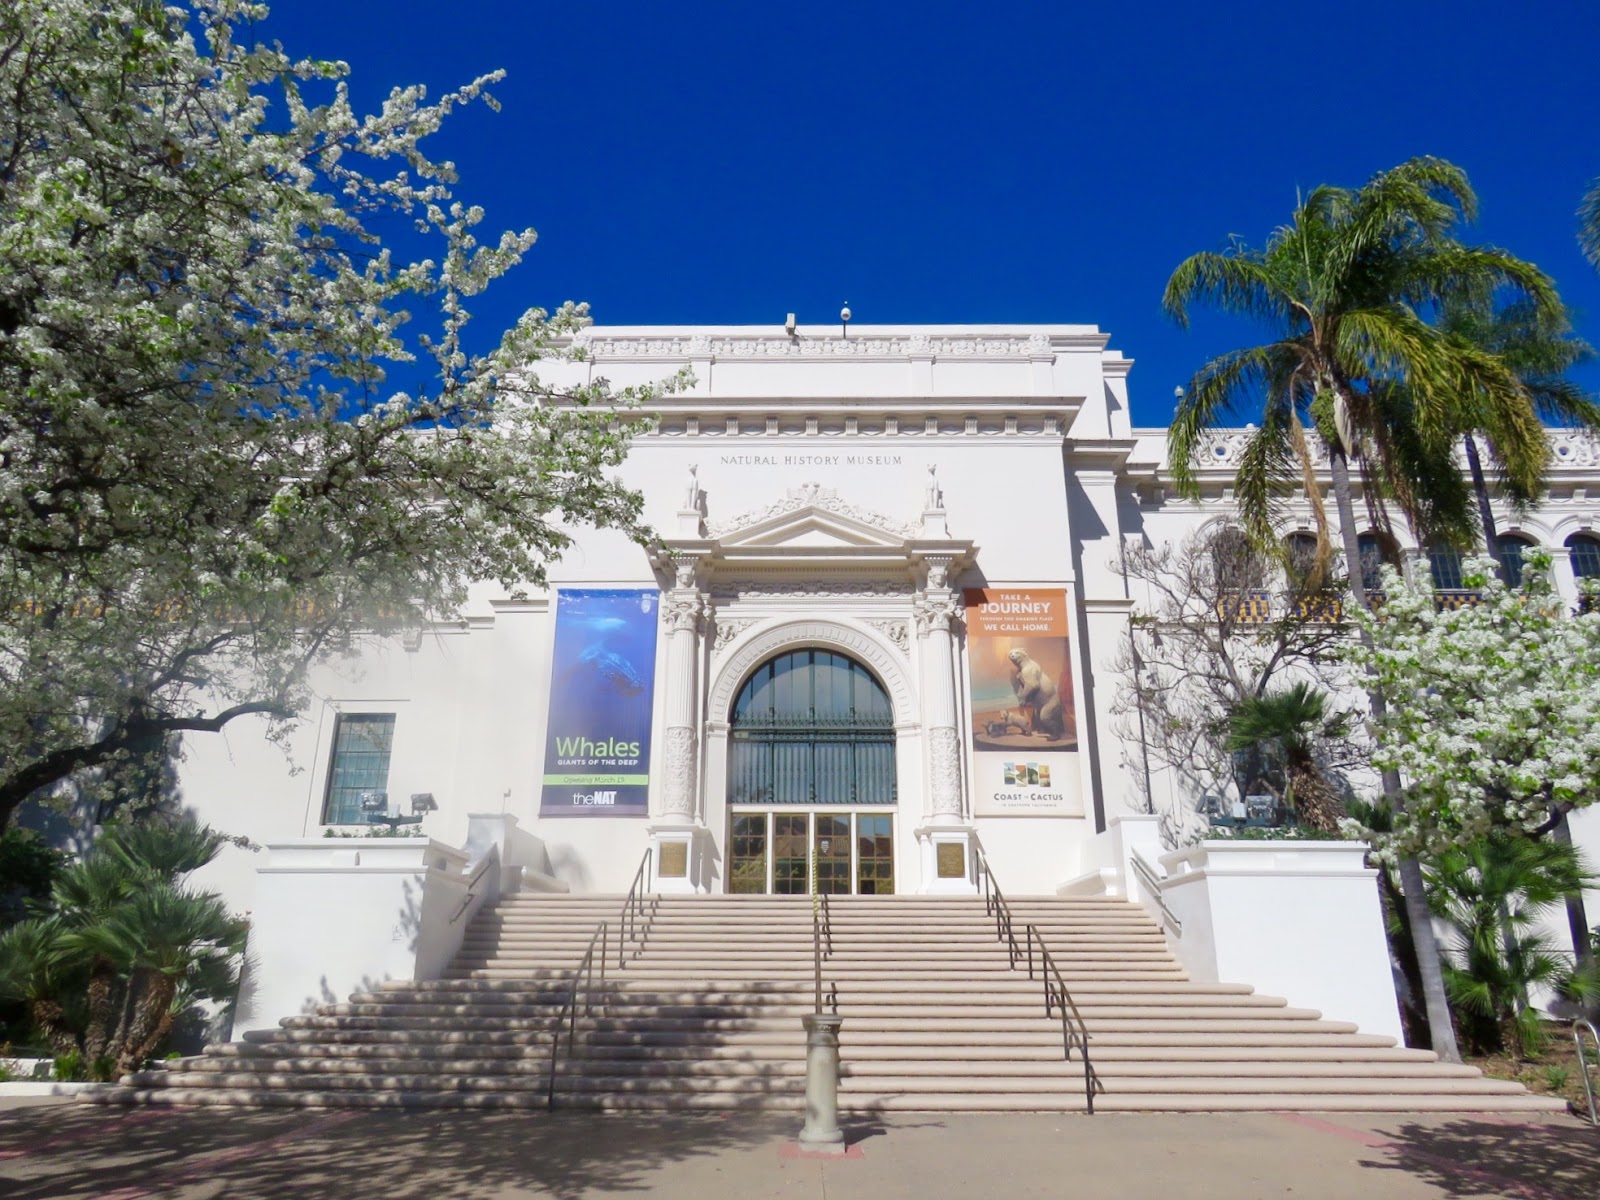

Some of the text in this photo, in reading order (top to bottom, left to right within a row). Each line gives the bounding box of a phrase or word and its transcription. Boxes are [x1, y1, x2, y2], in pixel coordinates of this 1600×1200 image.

[720, 456, 902, 465] NATURAL HISTORY MUSEUM
[980, 602, 1051, 614] JOURNEY
[556, 736, 640, 757] Whales
[993, 793, 1022, 801] COAST
[1030, 793, 1063, 801] CACTUS
